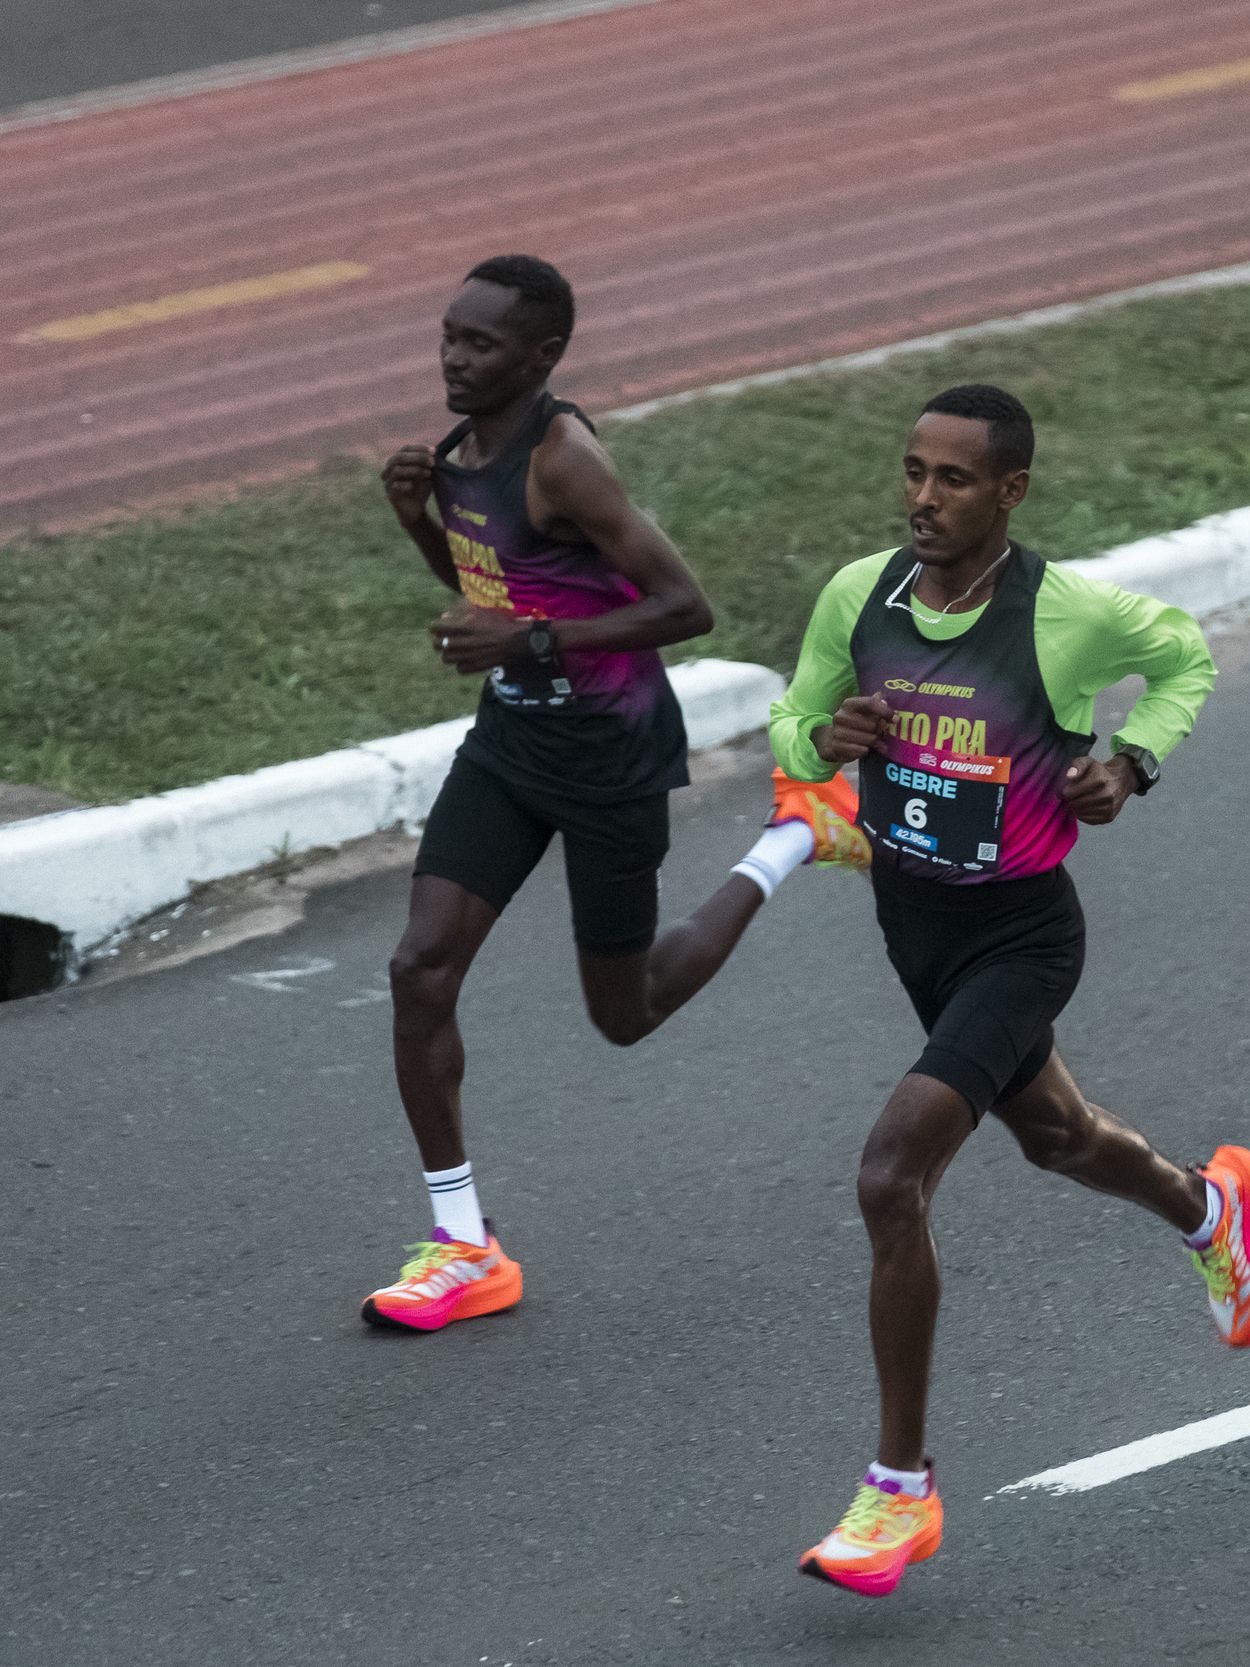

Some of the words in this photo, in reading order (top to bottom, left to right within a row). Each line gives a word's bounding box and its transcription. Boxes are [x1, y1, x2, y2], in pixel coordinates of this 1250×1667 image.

[918, 682, 976, 699] OLYMPIKUS
[935, 716, 987, 755] PRA
[885, 763, 958, 799] GEBRE
[940, 760, 995, 775] OLYMPIKUS
[904, 798, 928, 829] 6
